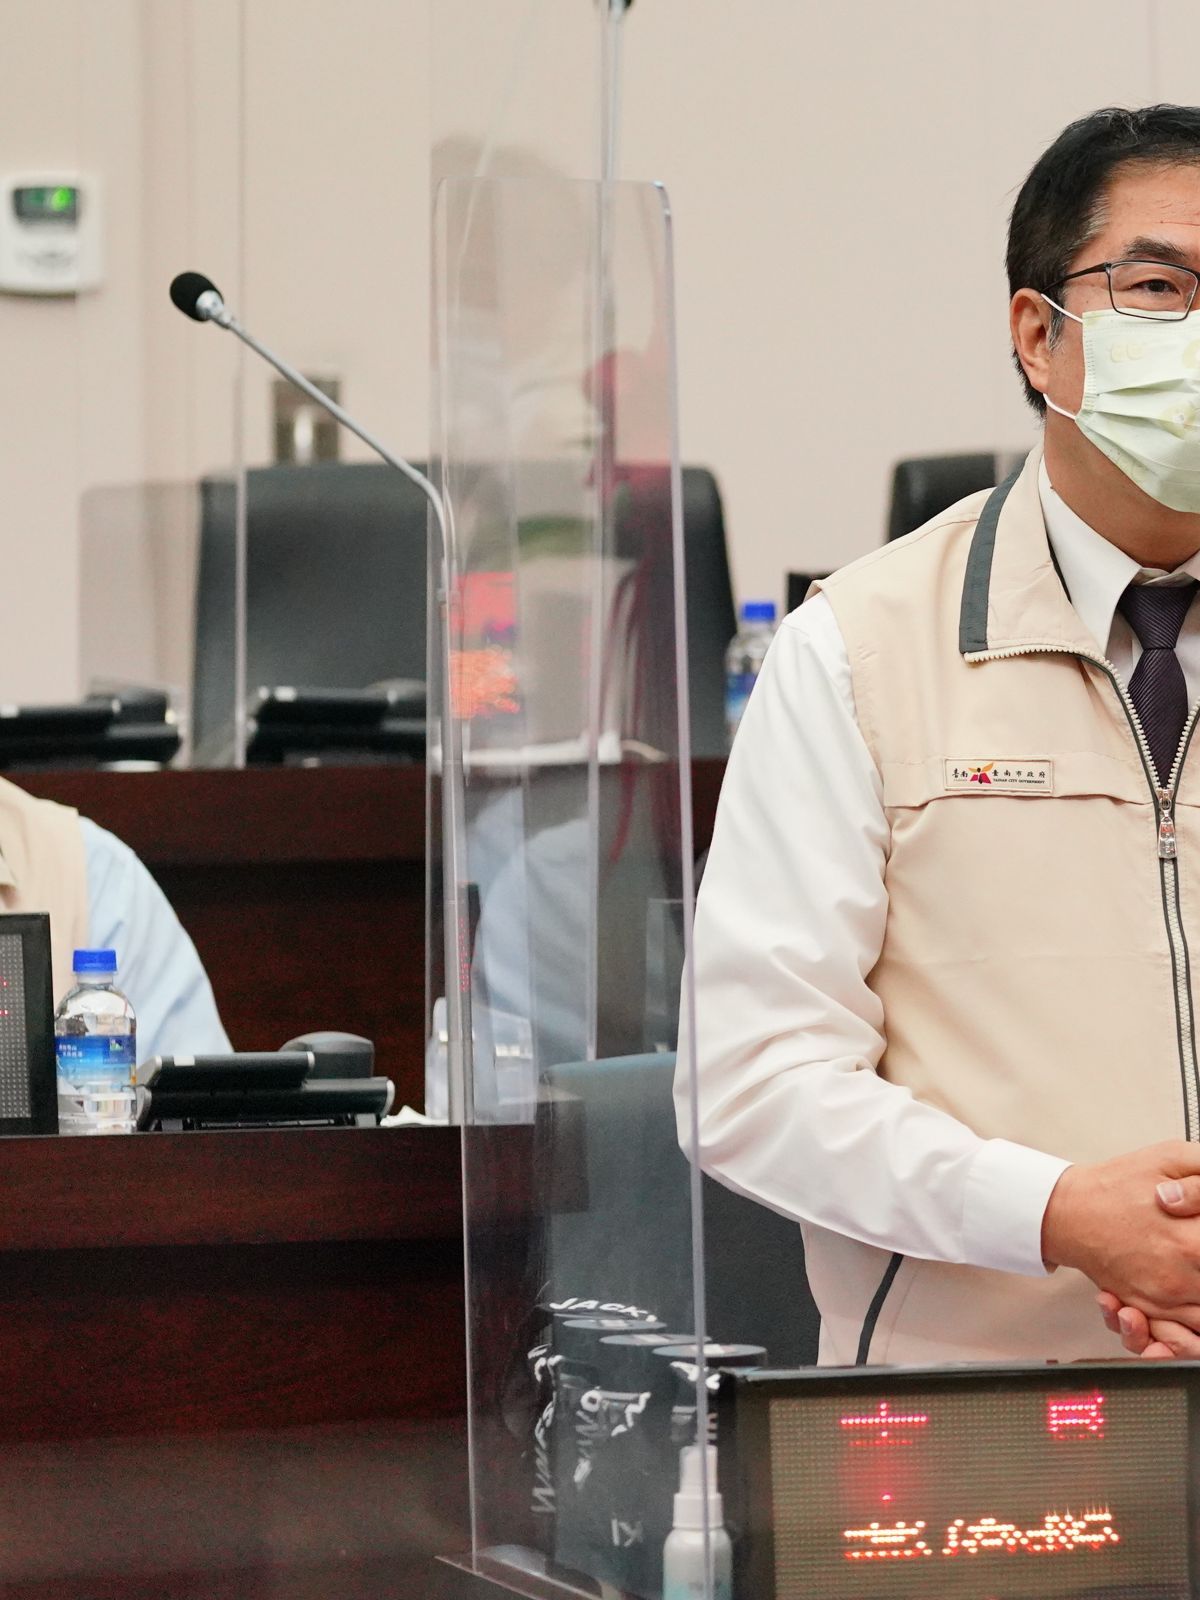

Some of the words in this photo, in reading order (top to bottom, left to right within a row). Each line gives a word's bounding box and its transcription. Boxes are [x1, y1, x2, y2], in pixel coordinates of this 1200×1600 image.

[992, 769, 1046, 779] 臺南市政府
